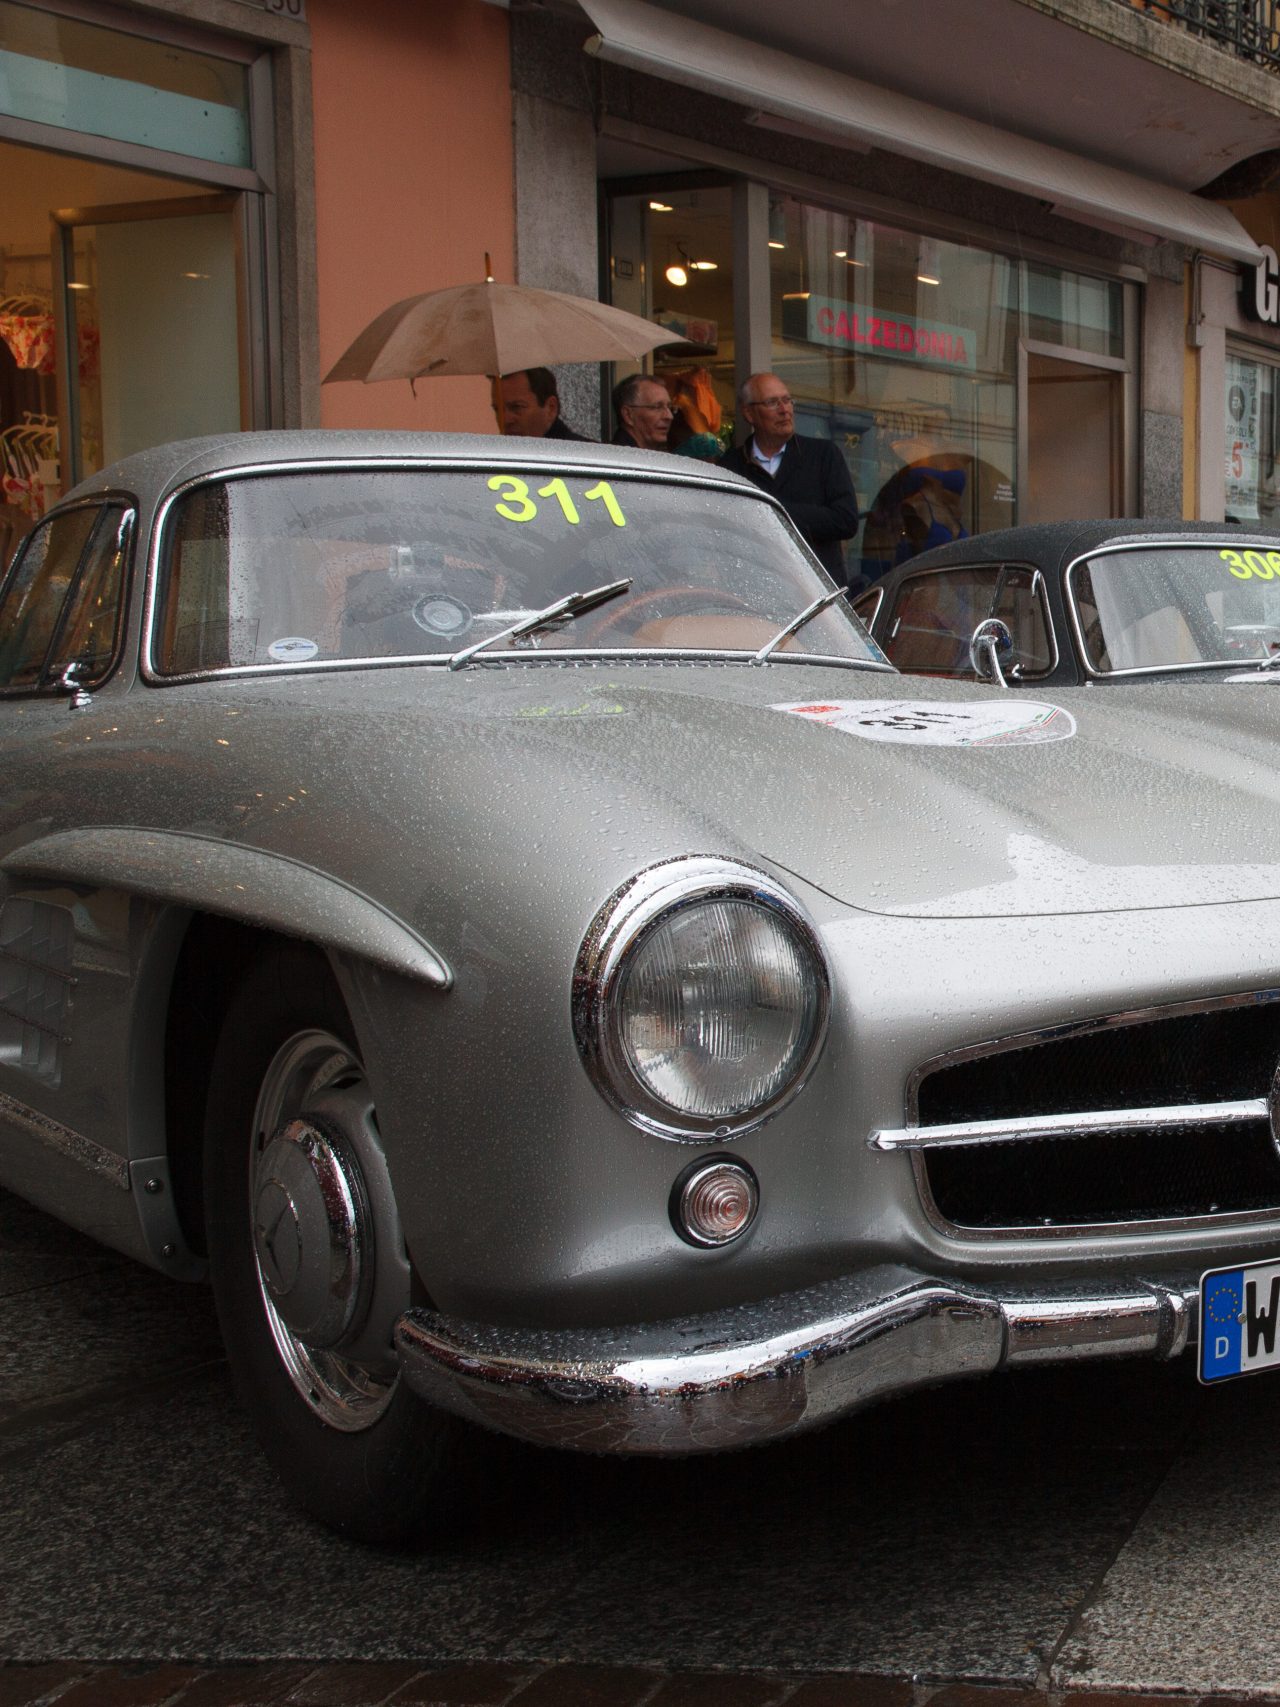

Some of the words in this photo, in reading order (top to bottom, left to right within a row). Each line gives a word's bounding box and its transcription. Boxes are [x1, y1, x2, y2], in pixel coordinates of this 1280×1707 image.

[817, 307, 968, 363] CALZEDONIA
[488, 475, 626, 527] 311
[1214, 1336, 1230, 1360] D
